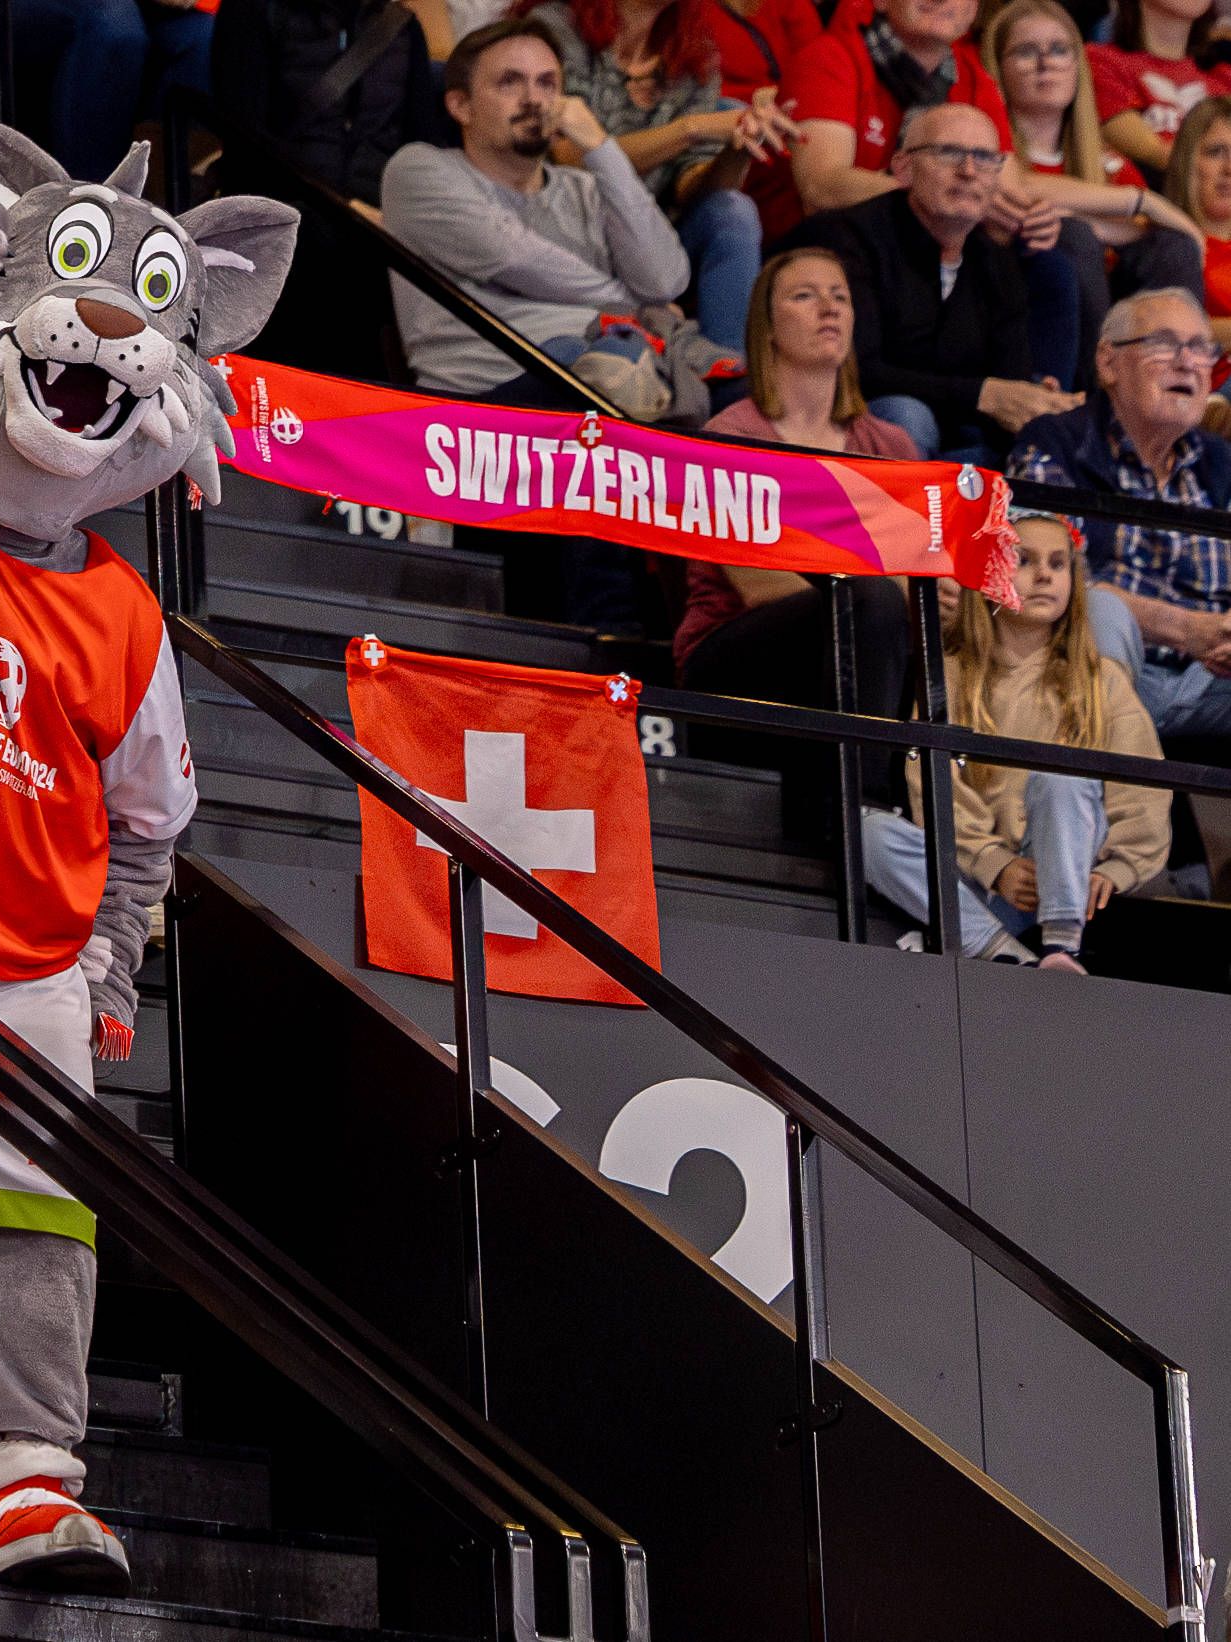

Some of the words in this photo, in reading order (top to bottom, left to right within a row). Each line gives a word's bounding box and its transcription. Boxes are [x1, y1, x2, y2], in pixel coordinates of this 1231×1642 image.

[424, 422, 782, 545] SWITZERLAND
[335, 500, 403, 540] 19
[923, 485, 943, 553] hummel
